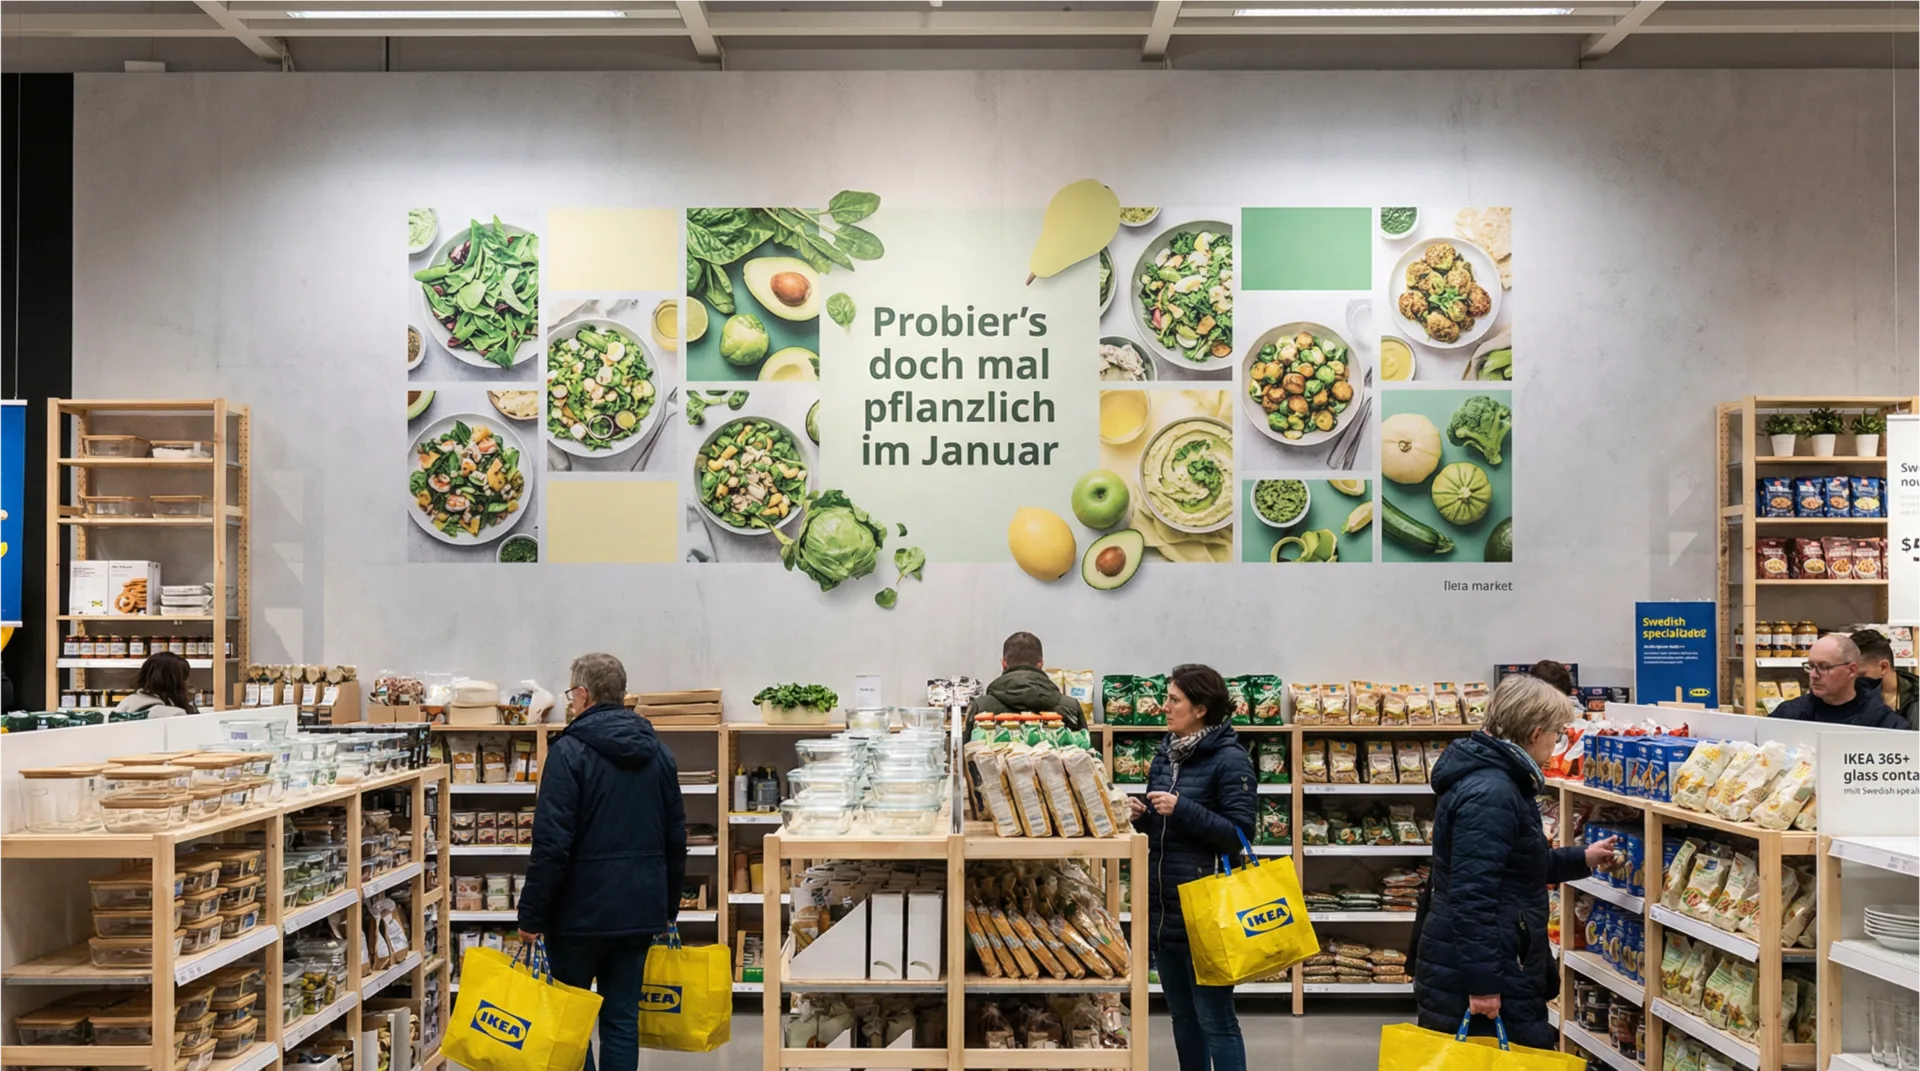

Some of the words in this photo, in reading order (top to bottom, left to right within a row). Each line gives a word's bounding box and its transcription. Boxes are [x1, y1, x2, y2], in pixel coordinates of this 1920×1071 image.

[869, 348, 963, 379] doch
[978, 348, 1049, 379] mal
[865, 391, 1055, 431] pflanzlich
[862, 434, 910, 465] im
[921, 436, 1059, 465] Januar
[1901, 462, 1920, 473] Sw
[1472, 580, 1513, 591] market
[1642, 616, 1686, 627] Swedish
[1844, 753, 1875, 765] IKEA
[1878, 753, 1910, 765] 365+
[1843, 769, 1879, 785] glass
[1246, 907, 1287, 927] IKEA
[640, 992, 676, 1004] KEA
[480, 1011, 521, 1039] IKEA
